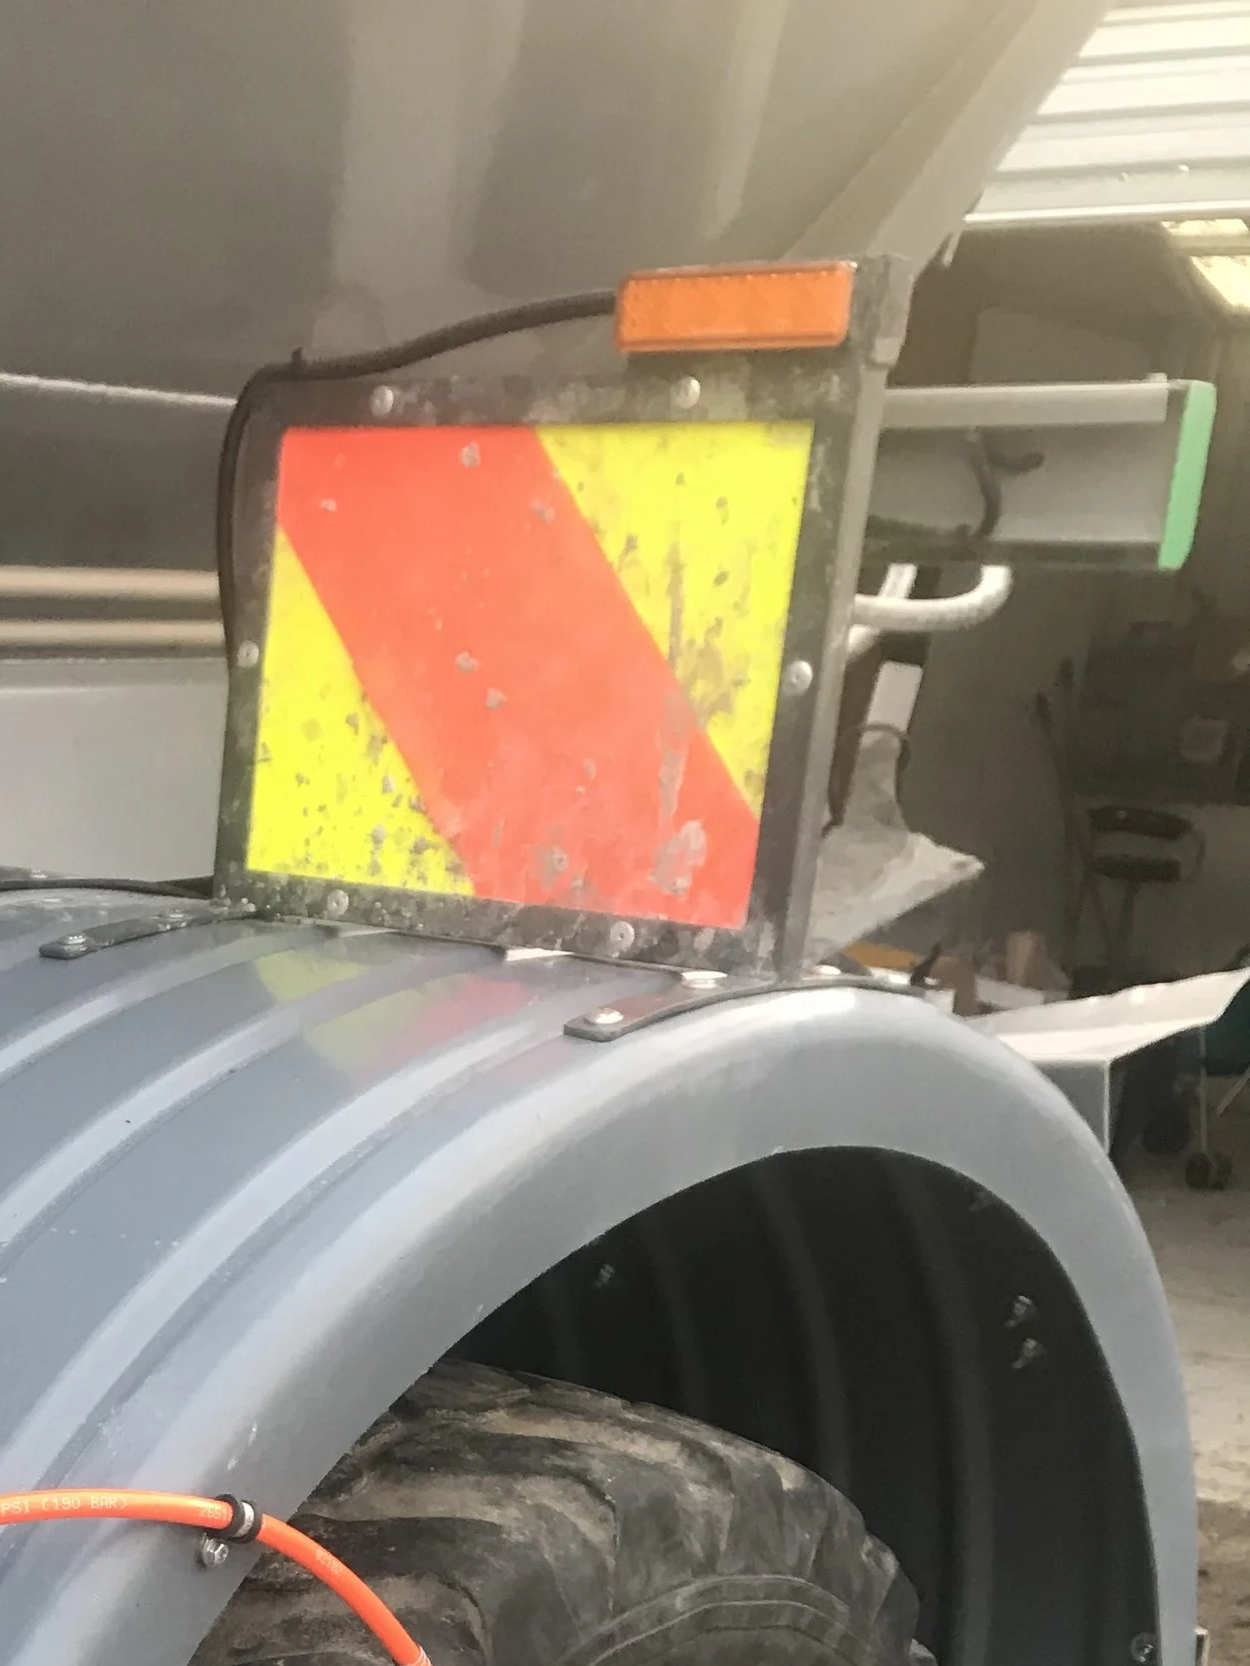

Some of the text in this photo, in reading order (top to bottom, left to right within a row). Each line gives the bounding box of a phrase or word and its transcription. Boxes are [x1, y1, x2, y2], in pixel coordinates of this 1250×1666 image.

[1, 1499, 31, 1516] PSI
[41, 1496, 82, 1512] (190
[89, 1495, 129, 1510] BAR)
